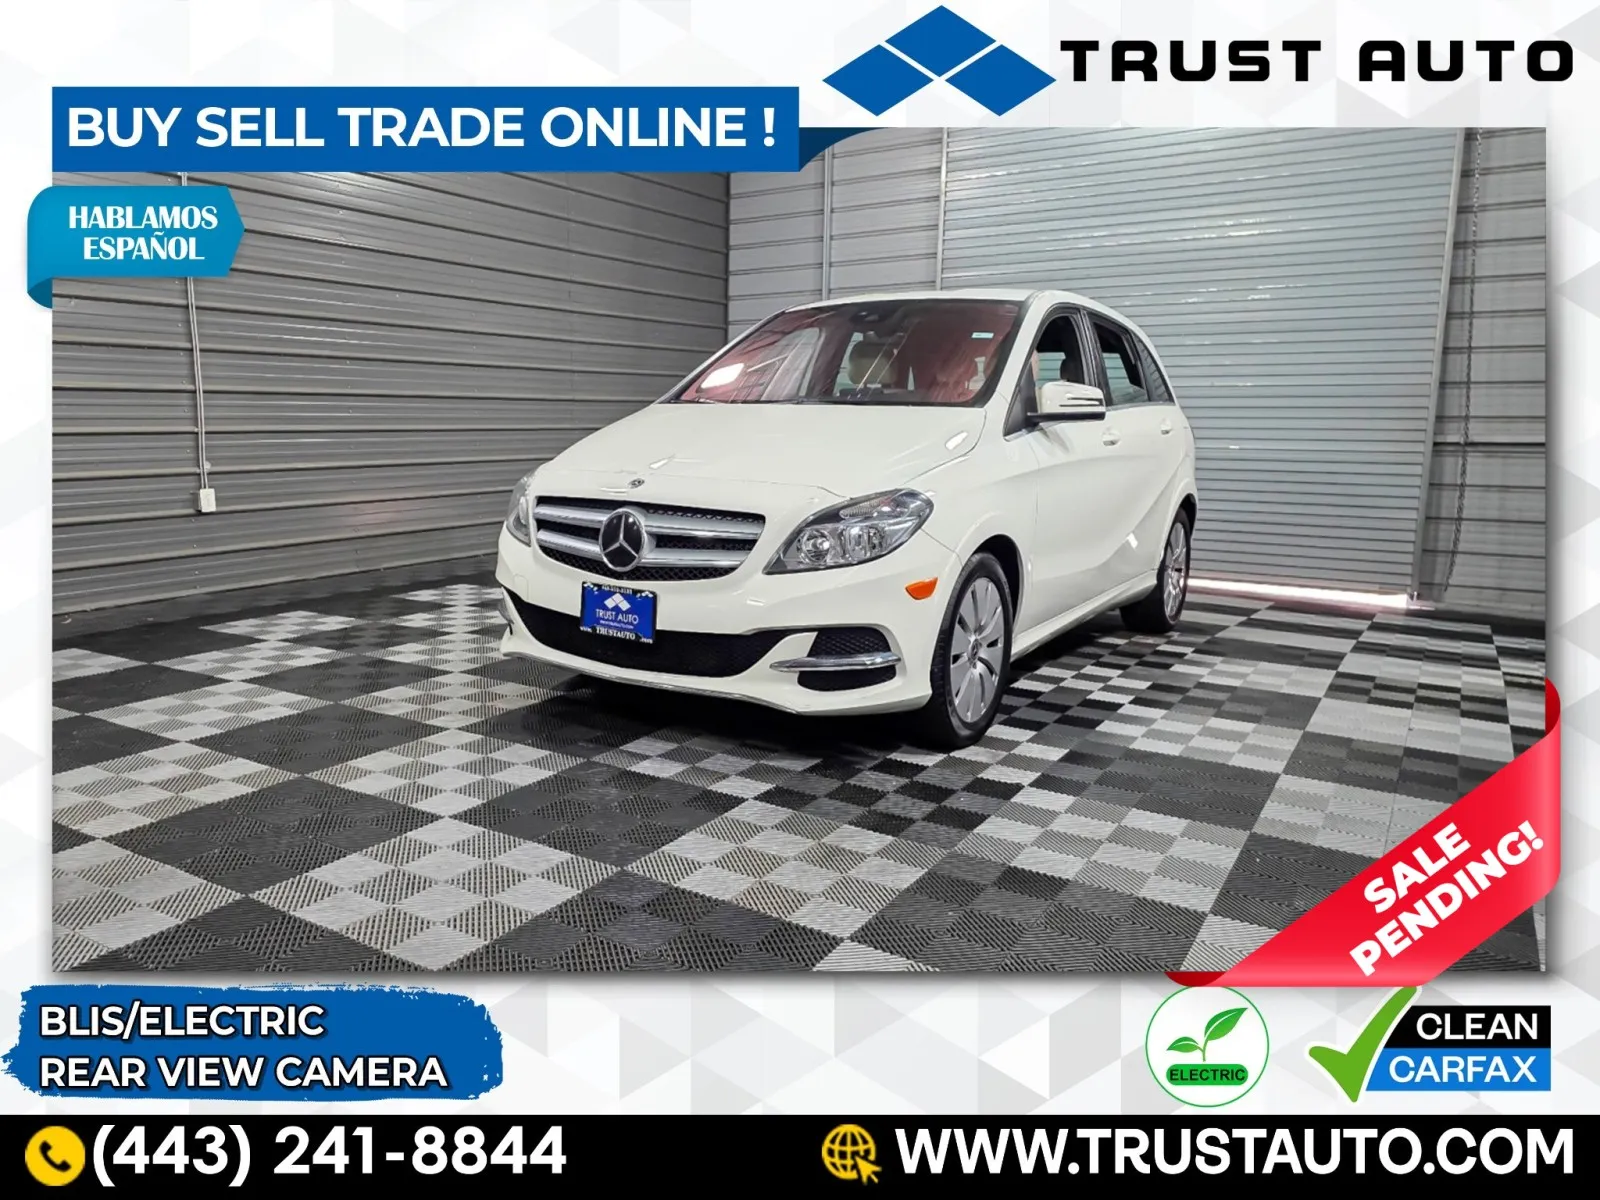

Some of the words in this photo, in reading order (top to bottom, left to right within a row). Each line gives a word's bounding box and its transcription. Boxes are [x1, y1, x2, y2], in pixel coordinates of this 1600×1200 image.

[595, 608, 616, 620] TRUST
[617, 613, 639, 624] AUTO
[596, 626, 636, 640] TRUSTAUTO
